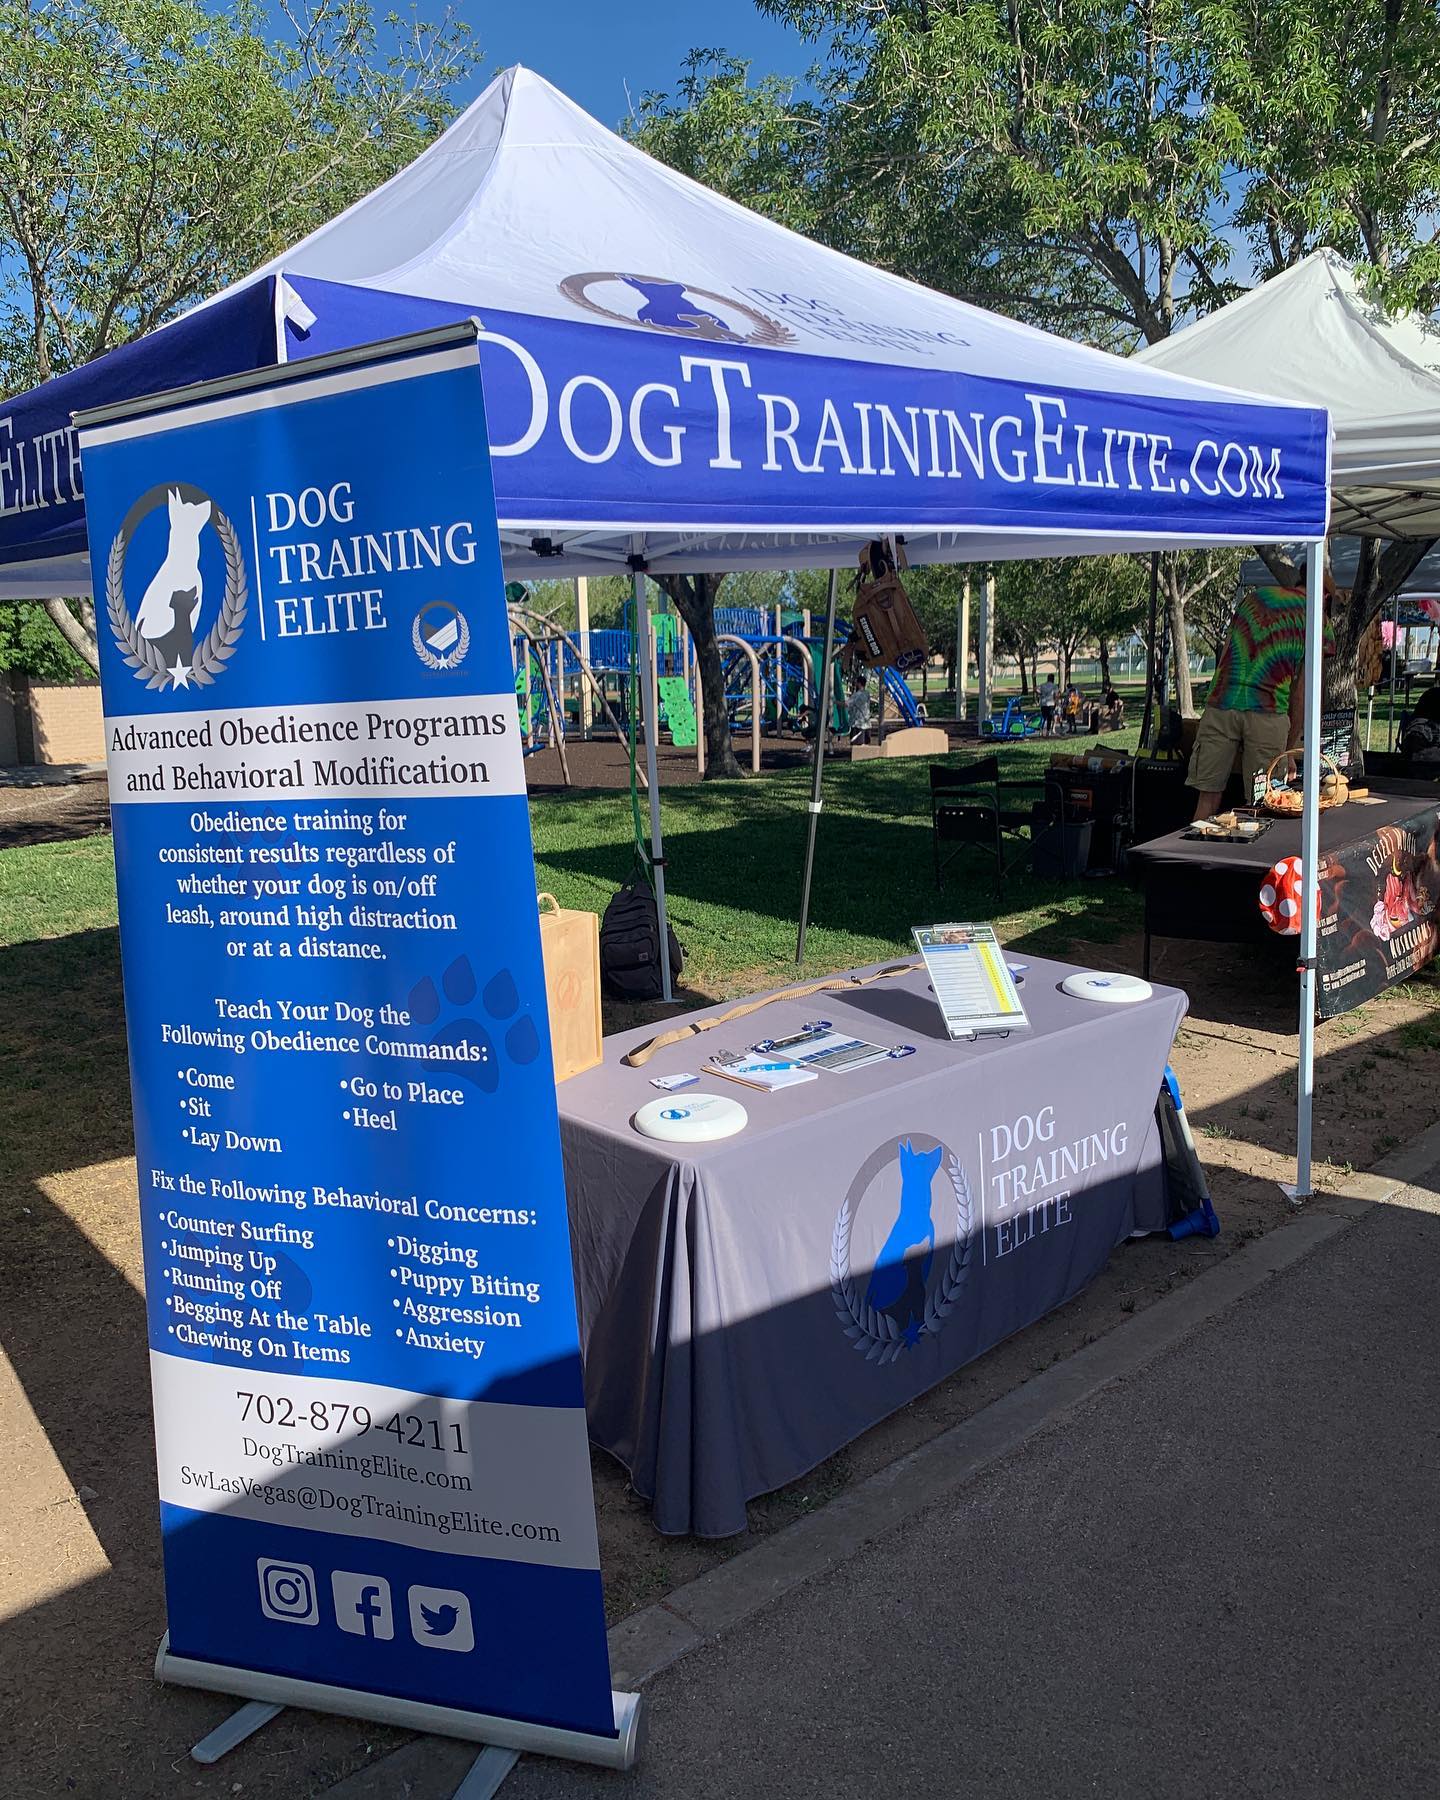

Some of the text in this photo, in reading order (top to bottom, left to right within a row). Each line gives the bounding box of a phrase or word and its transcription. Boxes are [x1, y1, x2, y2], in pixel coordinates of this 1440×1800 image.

[747, 288, 845, 316] DOG
[779, 308, 972, 346] TRAINING
[265, 482, 355, 532] DOG
[269, 522, 477, 584] TRAINING
[274, 589, 387, 637] ELITE
[111, 713, 506, 752] Advanced Obedience Programs
[127, 754, 490, 792] and Behavioral Modification
[190, 807, 407, 836] Obedience training for
[158, 840, 457, 868] consistent results regardless of
[176, 872, 438, 901] whether your dog is on/off
[166, 902, 458, 932] leash, around high distraction
[226, 936, 387, 960] or at a distance.
[214, 998, 411, 1029] Teach Your Dog the
[160, 1024, 488, 1062] Following Obedience Commands:
[382, 1081, 403, 1101] to
[407, 1081, 465, 1106] Place
[224, 1130, 283, 1153] Down
[989, 1106, 1055, 1162] DOG
[991, 1123, 1128, 1209] TRAINING
[151, 1169, 537, 1225] Fix the Following Behavioral Concerns:
[240, 1220, 315, 1250] Surfing
[995, 1190, 1072, 1259] ELITE
[247, 1250, 277, 1276] Up
[250, 1279, 283, 1300] Off
[470, 1274, 540, 1303] Biting
[248, 1307, 272, 1328] At
[275, 1309, 309, 1331] the
[313, 1314, 372, 1338] Table
[257, 1337, 288, 1358] On
[291, 1340, 351, 1364] Items
[236, 1391, 468, 1455] 702-879-4211
[243, 1437, 472, 1492] DogTrainingElite.com
[181, 1466, 561, 1543] SwLasVegas@DogTrainingElite.com
